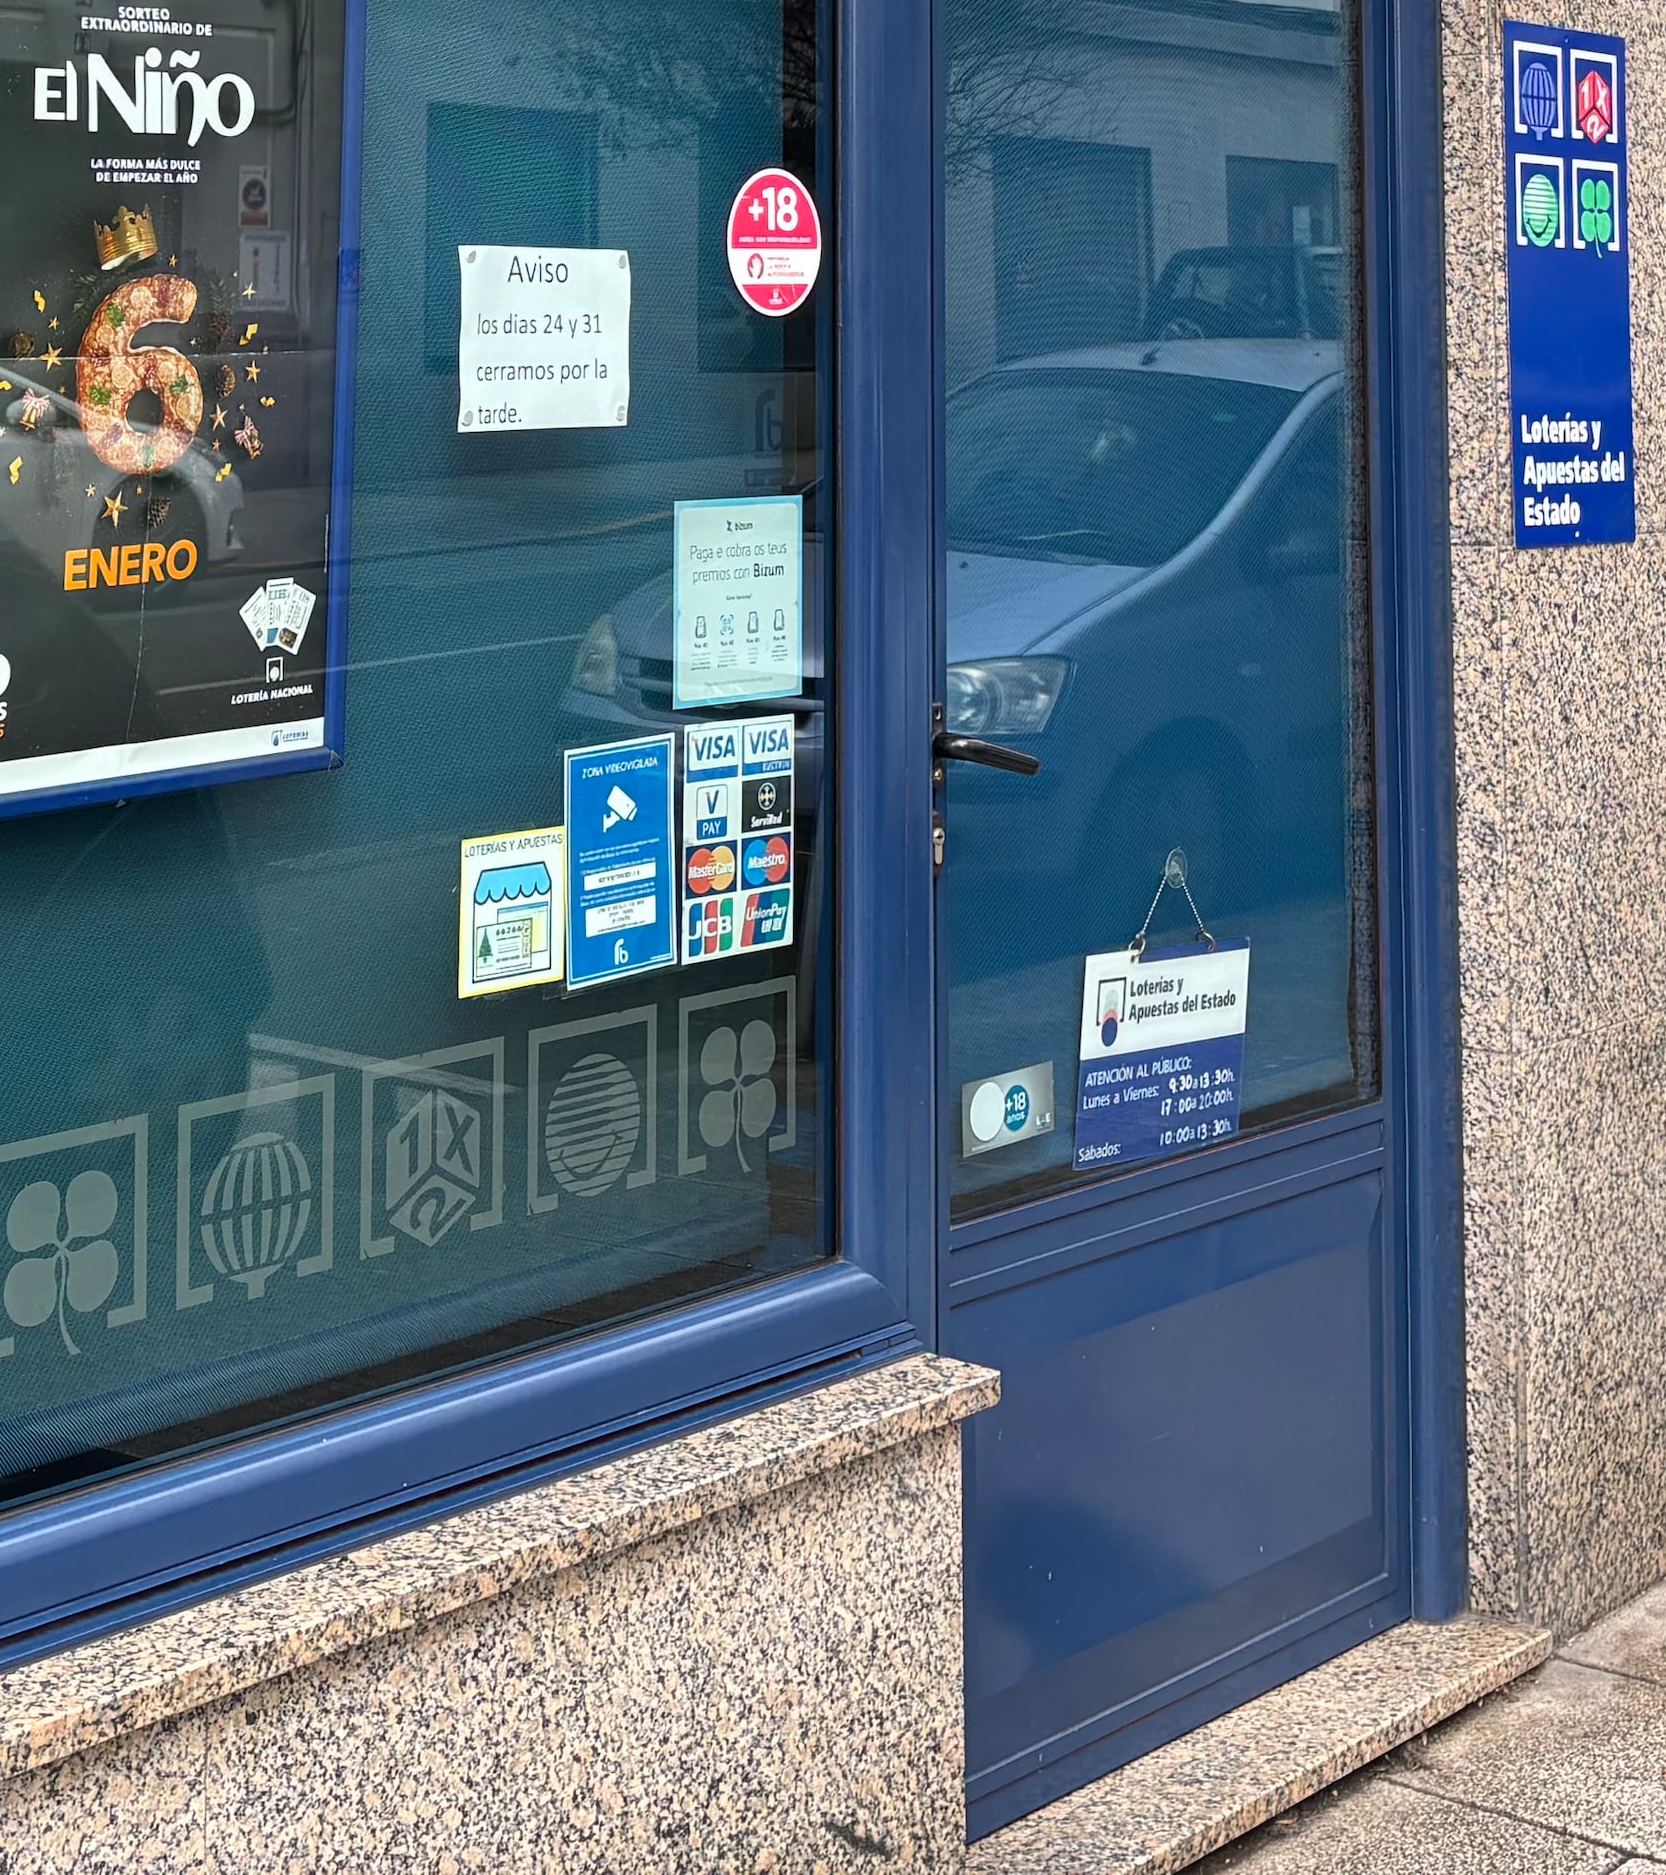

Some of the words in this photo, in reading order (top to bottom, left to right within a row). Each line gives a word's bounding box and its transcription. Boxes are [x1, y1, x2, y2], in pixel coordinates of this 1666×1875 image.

[118, 6, 171, 20] SORTEO
[81, 17, 192, 35] EXTRAORDINARIO
[196, 24, 212, 36] DE
[34, 60, 77, 121] El
[87, 46, 255, 147] Niño
[91, 159, 103, 169] LA
[105, 158, 143, 170] FORMA
[146, 157, 168, 170] MÁS
[170, 160, 201, 170] DULCE
[96, 172, 110, 183] DE
[112, 172, 161, 183] EMPEZAR
[163, 173, 174, 183] EL
[176, 171, 198, 184] AÑO
[748, 186, 798, 231] +18
[507, 254, 569, 284] Aviso
[477, 313, 498, 336] los
[543, 313, 563, 335] 24
[569, 318, 579, 339] y
[583, 313, 602, 334] 31
[476, 361, 554, 382] cerramos
[560, 363, 589, 385] por
[595, 359, 608, 380] la
[477, 402, 522, 425] tarde.
[1521, 413, 1587, 444] Loterías
[1590, 418, 1601, 450] y
[1523, 455, 1599, 493] Apuestas
[1601, 452, 1626, 483] del
[1523, 494, 1581, 528] Estado
[690, 545, 713, 562] Paga
[717, 547, 722, 559] e
[726, 543, 751, 557] cobra
[754, 544, 764, 556] os
[768, 541, 787, 554] teus
[63, 539, 198, 591] ENERO
[693, 568, 730, 585] premios
[734, 567, 749, 580] con
[753, 563, 784, 578] Bizum
[231, 689, 268, 705] LOTERÍA
[270, 684, 313, 701] NACIONAL
[694, 734, 735, 761] VISA
[749, 730, 789, 755] VISA
[582, 765, 604, 779] ZONA
[706, 789, 719, 815] V
[702, 821, 720, 836] PAY
[464, 841, 507, 858] LOTERÍAS
[509, 840, 516, 852] Y
[517, 833, 563, 850] APUESTAS
[689, 861, 735, 880] MasterCard
[747, 853, 786, 870] Maestro
[688, 914, 733, 940] JCB
[746, 902, 786, 922] UnionPay
[1130, 976, 1174, 997] Loterías
[1176, 978, 1184, 996] y
[1129, 1000, 1179, 1024] Apuestas
[1182, 994, 1198, 1013] del
[1201, 989, 1236, 1010] Estado
[1085, 1066, 1133, 1088] ATENCIÓN
[1136, 1064, 1149, 1079] AL
[1151, 1056, 1192, 1075] PÚBLICO:
[1006, 1092, 1027, 1111] +18
[1083, 1092, 1111, 1110] Lunes
[1114, 1092, 1120, 1104] a
[1123, 1085, 1160, 1102] Viernes:
[1078, 1141, 1121, 1162] Sábados:
